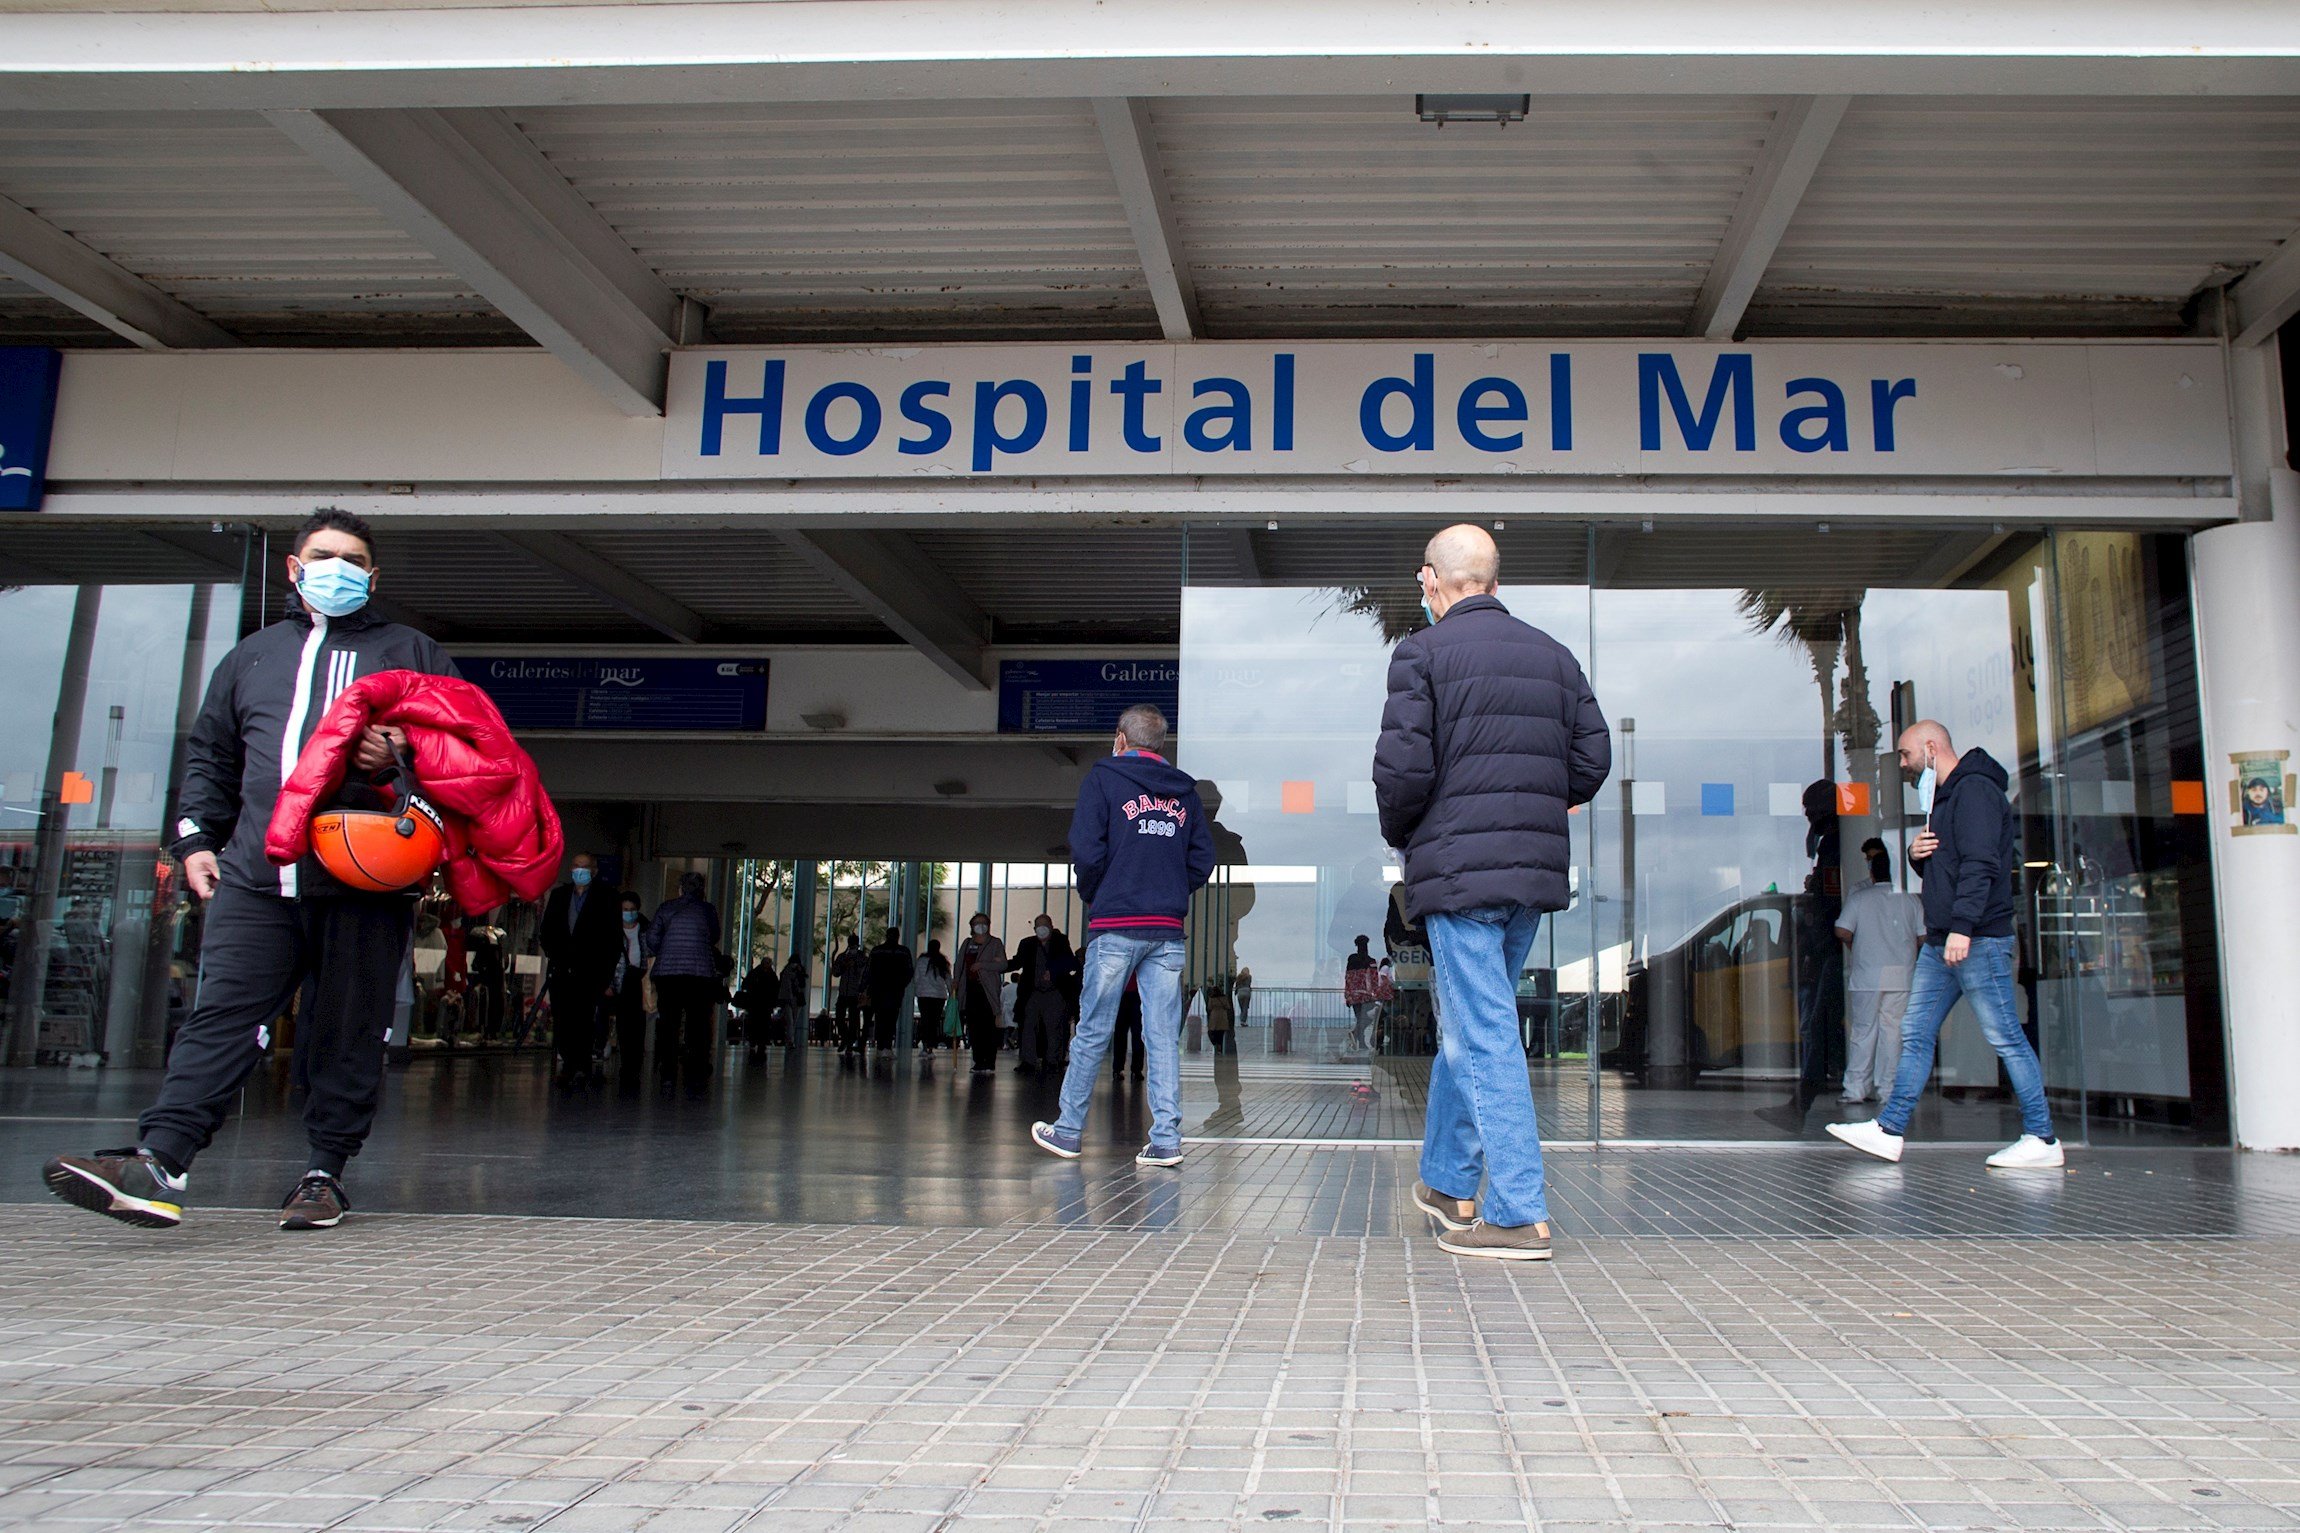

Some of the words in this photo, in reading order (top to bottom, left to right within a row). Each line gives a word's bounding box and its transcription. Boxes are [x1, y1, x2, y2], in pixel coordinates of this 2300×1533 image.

[699, 353, 1294, 472] Hospital
[1360, 353, 1573, 452] del
[1638, 353, 1917, 452] Mar
[1138, 819, 1177, 838] 1899
